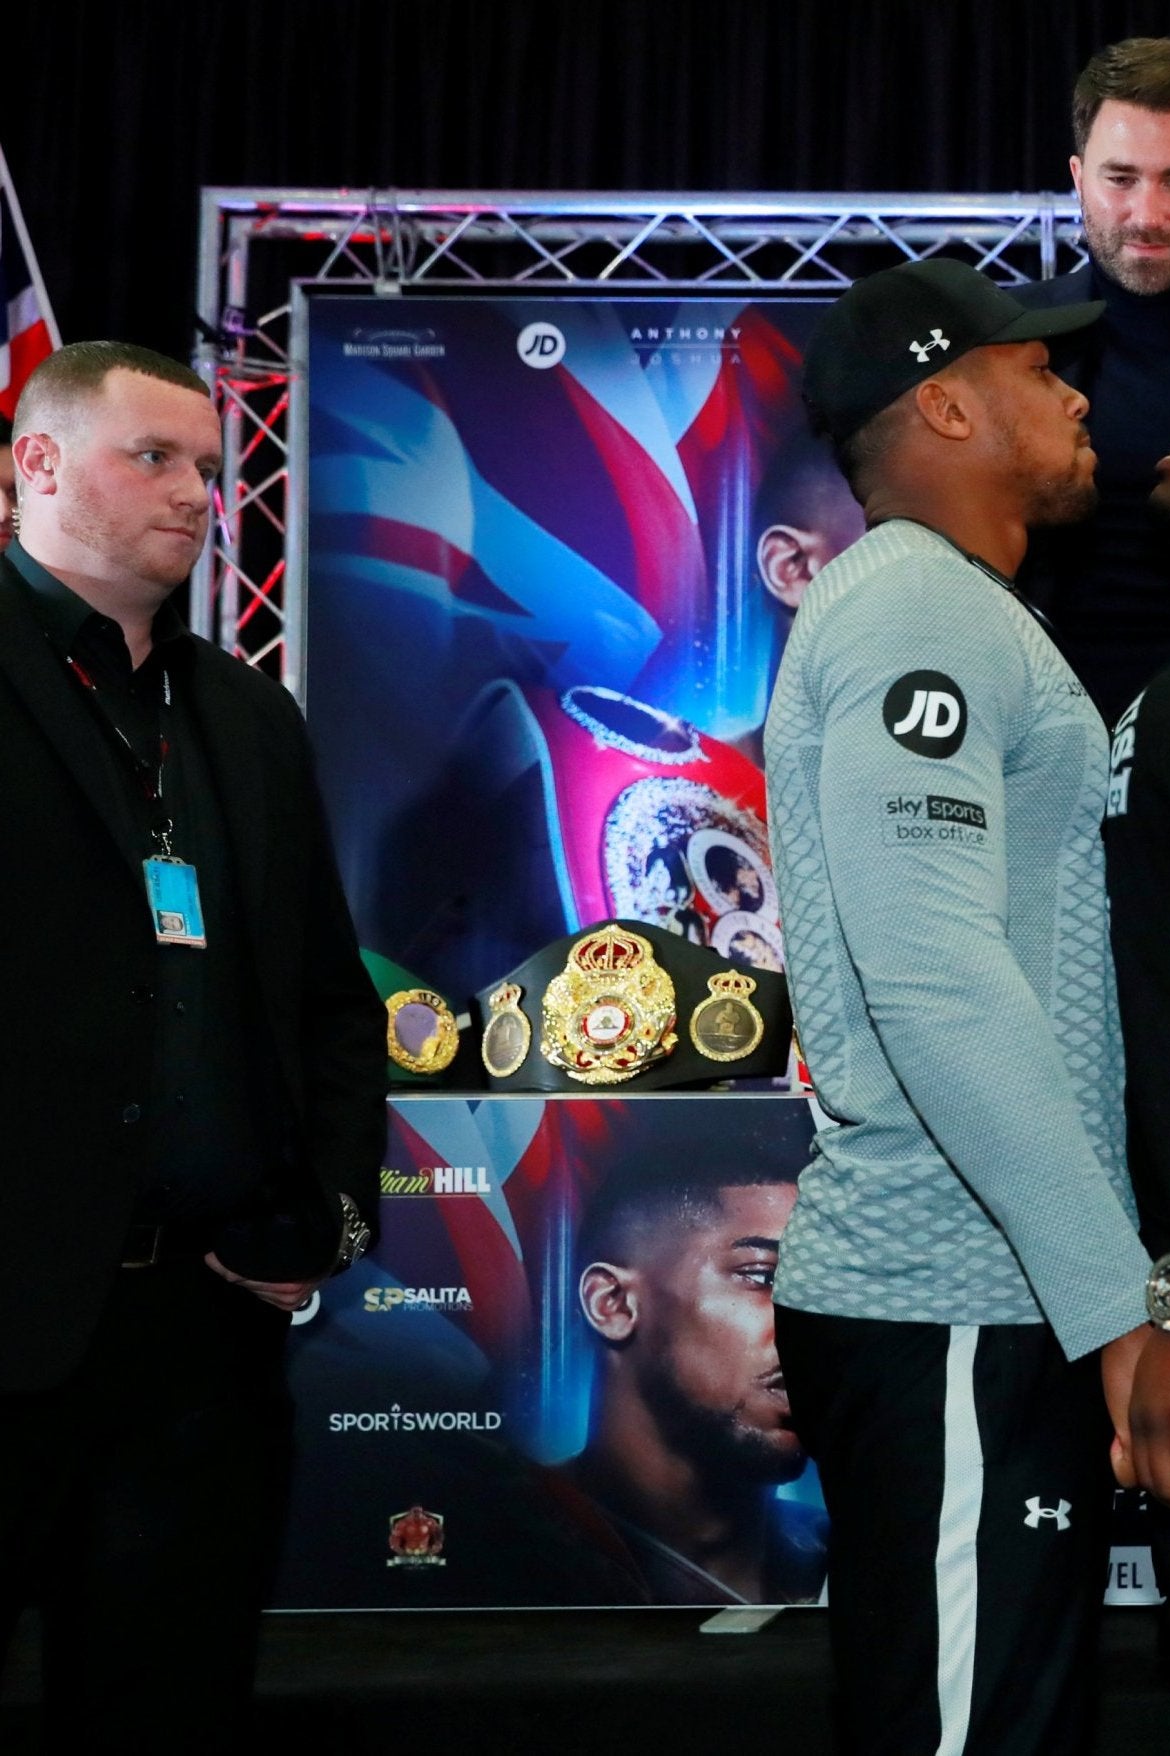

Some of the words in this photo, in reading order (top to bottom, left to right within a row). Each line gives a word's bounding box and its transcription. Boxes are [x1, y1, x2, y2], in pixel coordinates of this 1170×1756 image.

[525, 334, 558, 356] JD
[631, 327, 741, 340] ANTHONY
[631, 353, 741, 365] JOSHUA
[894, 690, 960, 738] JD
[887, 796, 922, 817] sky
[930, 800, 984, 824] sports
[896, 825, 933, 839] box
[434, 1168, 491, 1193] HILL
[329, 1408, 502, 1432] SPORTSWORLD
